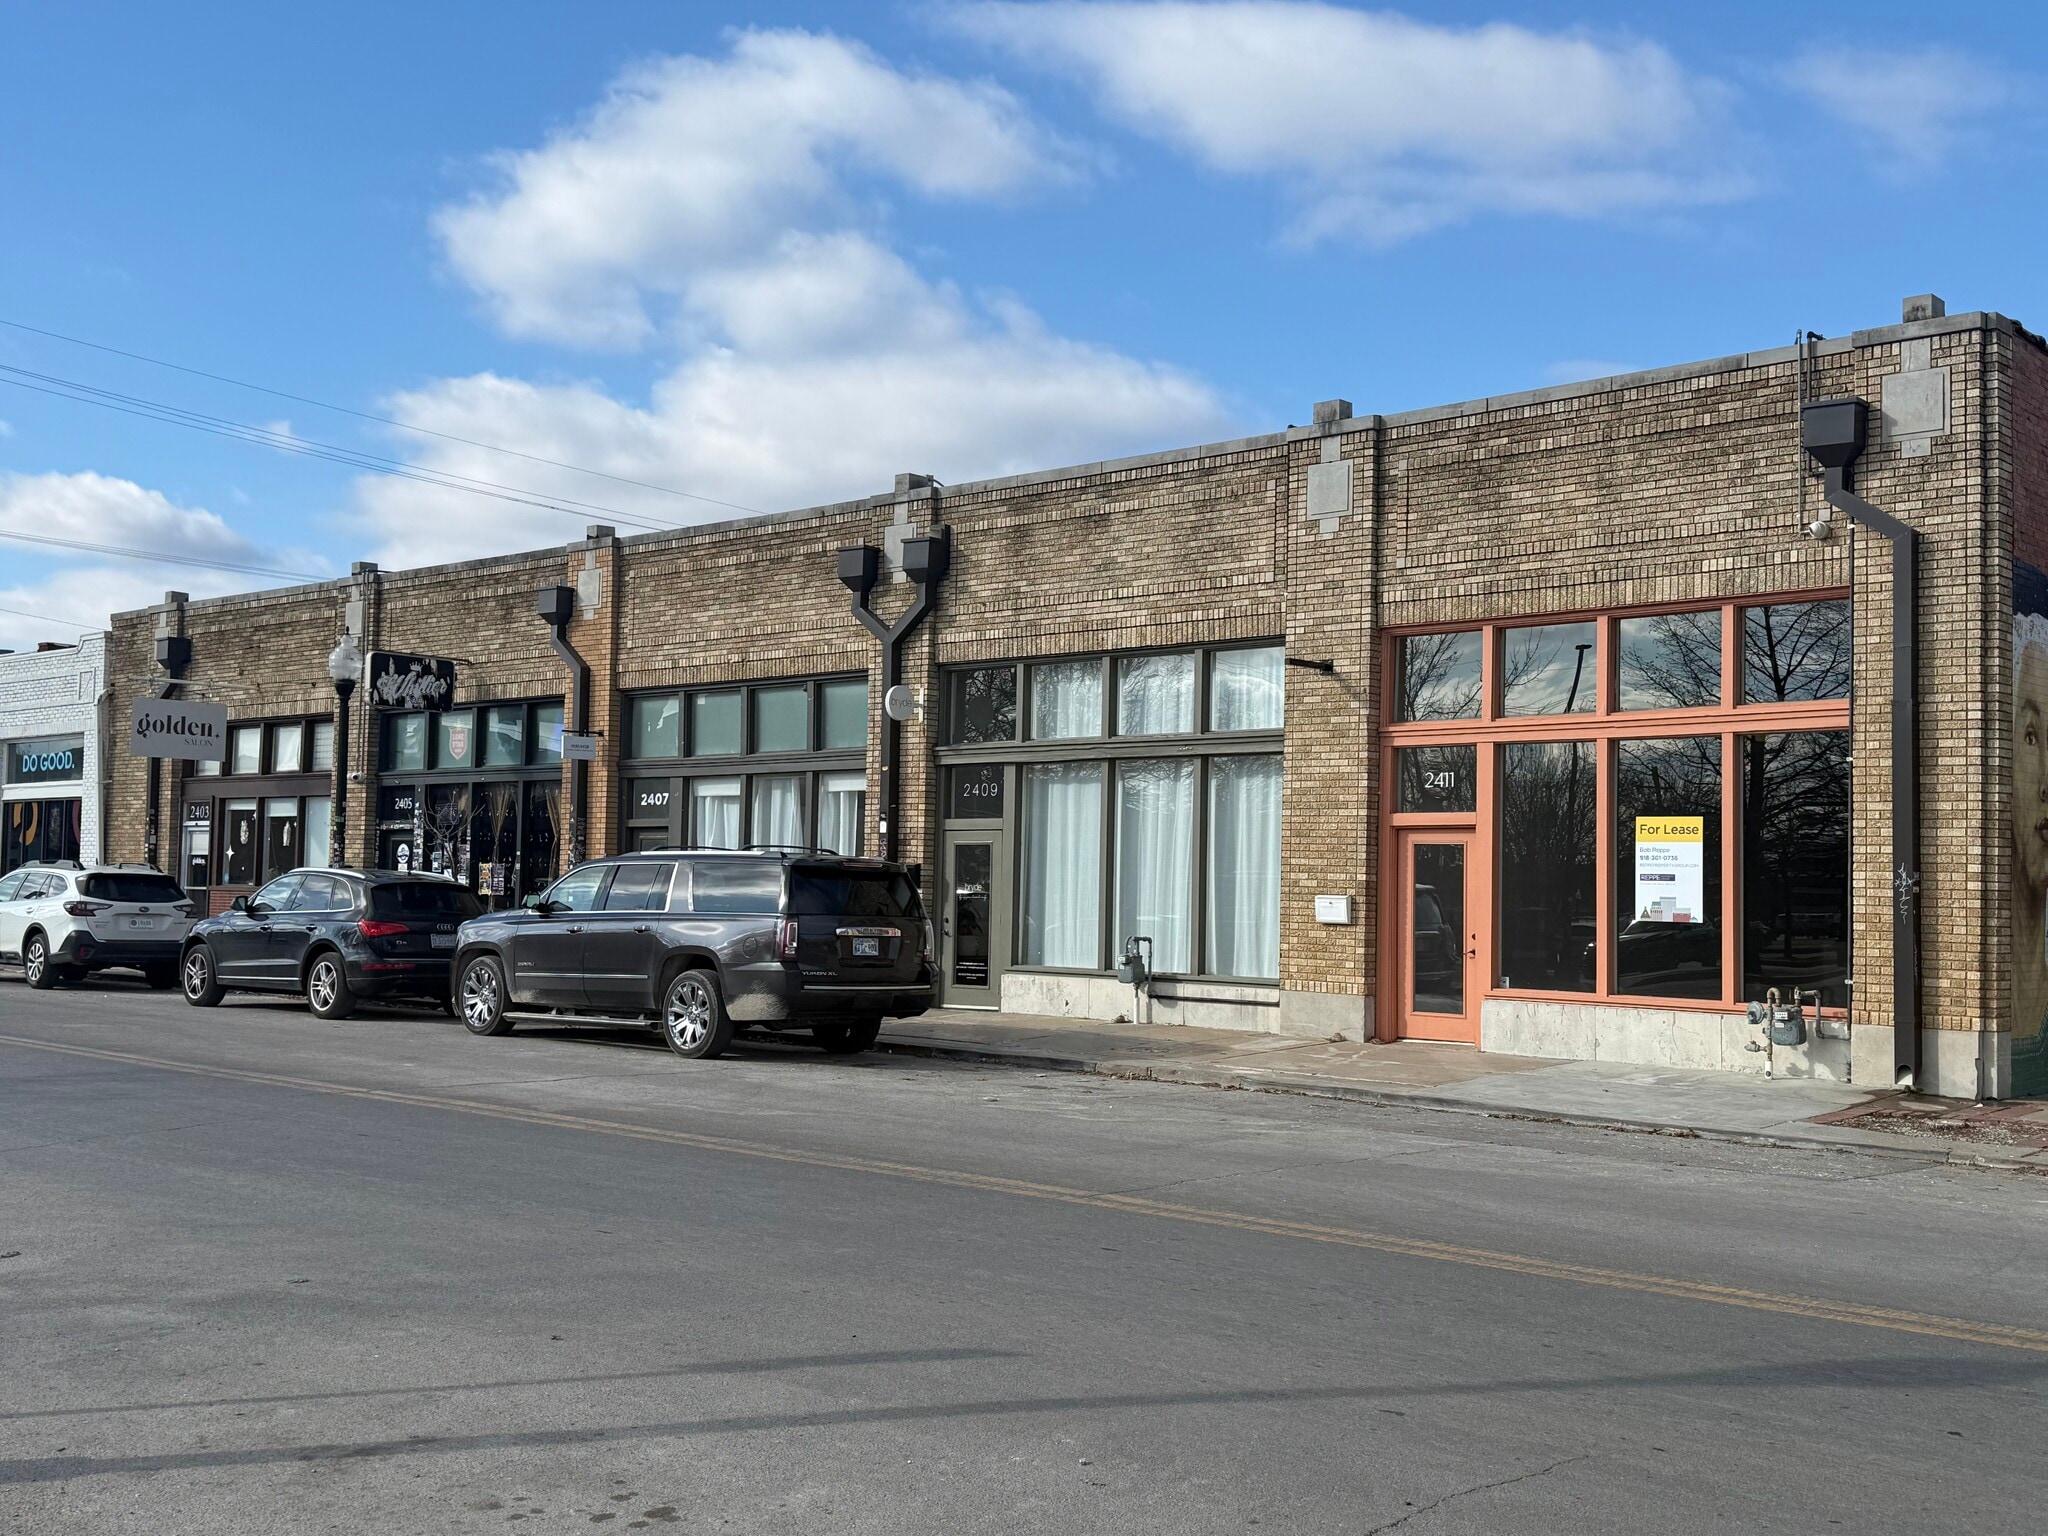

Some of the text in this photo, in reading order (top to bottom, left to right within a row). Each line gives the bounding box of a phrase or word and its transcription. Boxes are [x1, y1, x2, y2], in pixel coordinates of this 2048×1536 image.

[184, 738, 213, 746] SALON
[22, 751, 75, 772] DO GOOD.
[1424, 771, 1455, 788] 2411
[963, 783, 998, 797] 2409
[394, 797, 413, 810] 2405
[640, 792, 670, 806] 2407
[190, 805, 210, 819] 2403
[1640, 824, 1699, 834] For Lease
